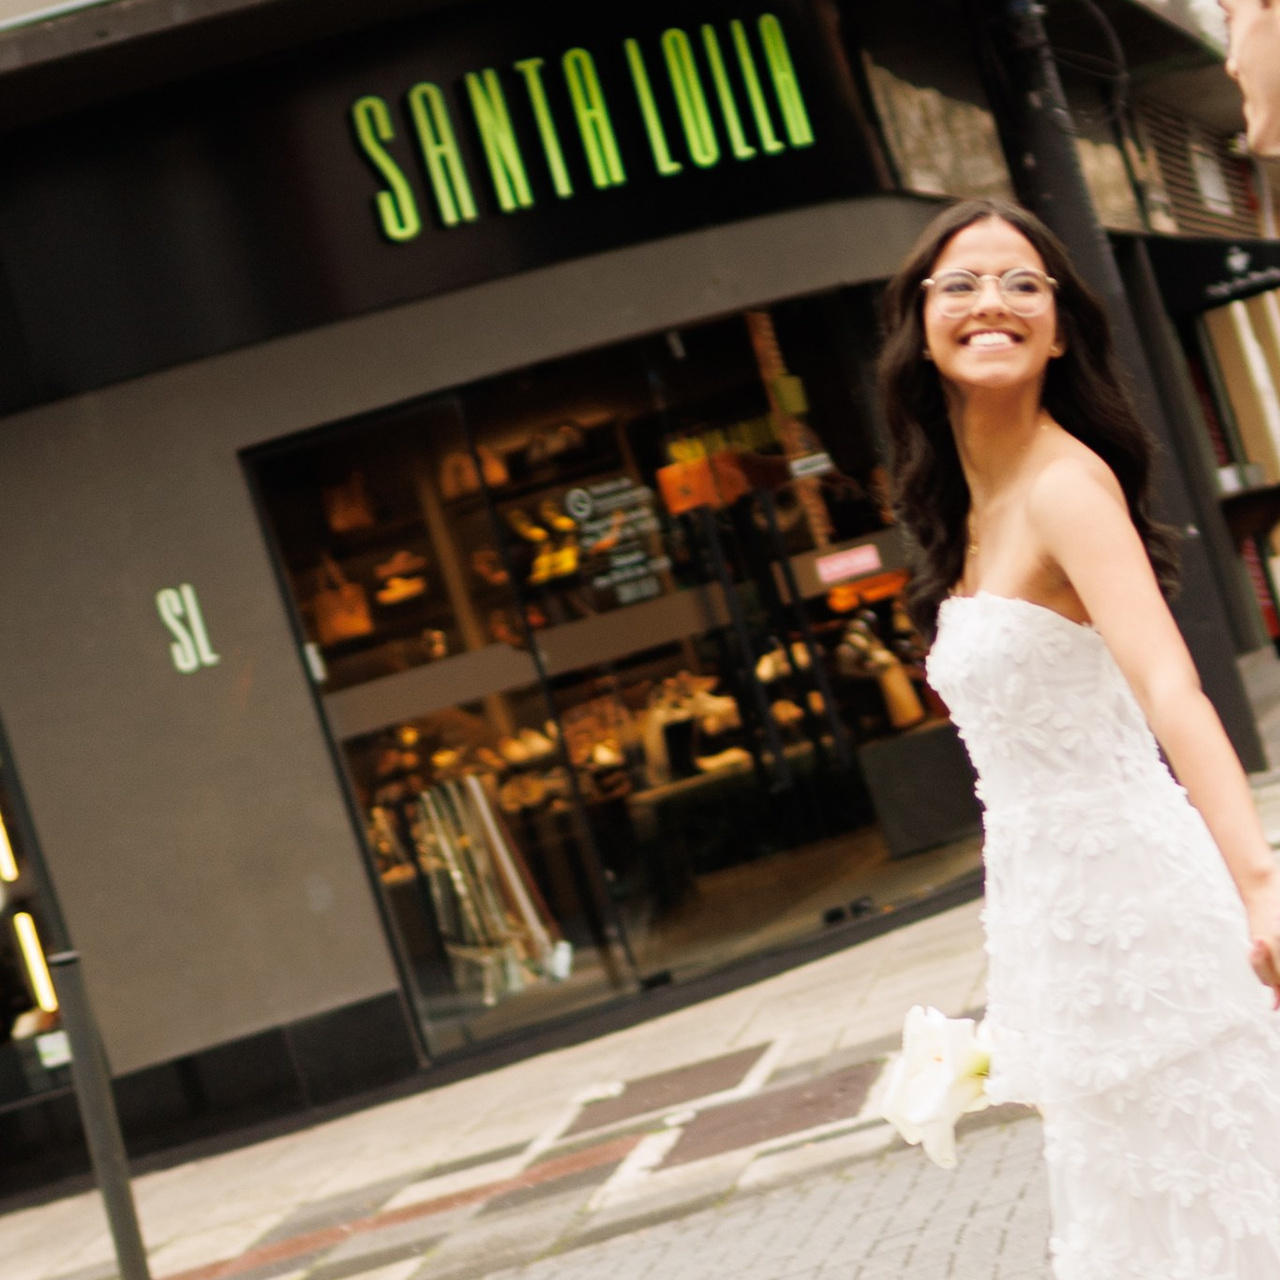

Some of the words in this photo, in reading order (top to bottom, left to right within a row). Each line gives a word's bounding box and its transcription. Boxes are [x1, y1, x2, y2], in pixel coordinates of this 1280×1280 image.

[352, 47, 627, 242] SANTA
[624, 13, 815, 176] LOLLA
[155, 582, 221, 674] SL
